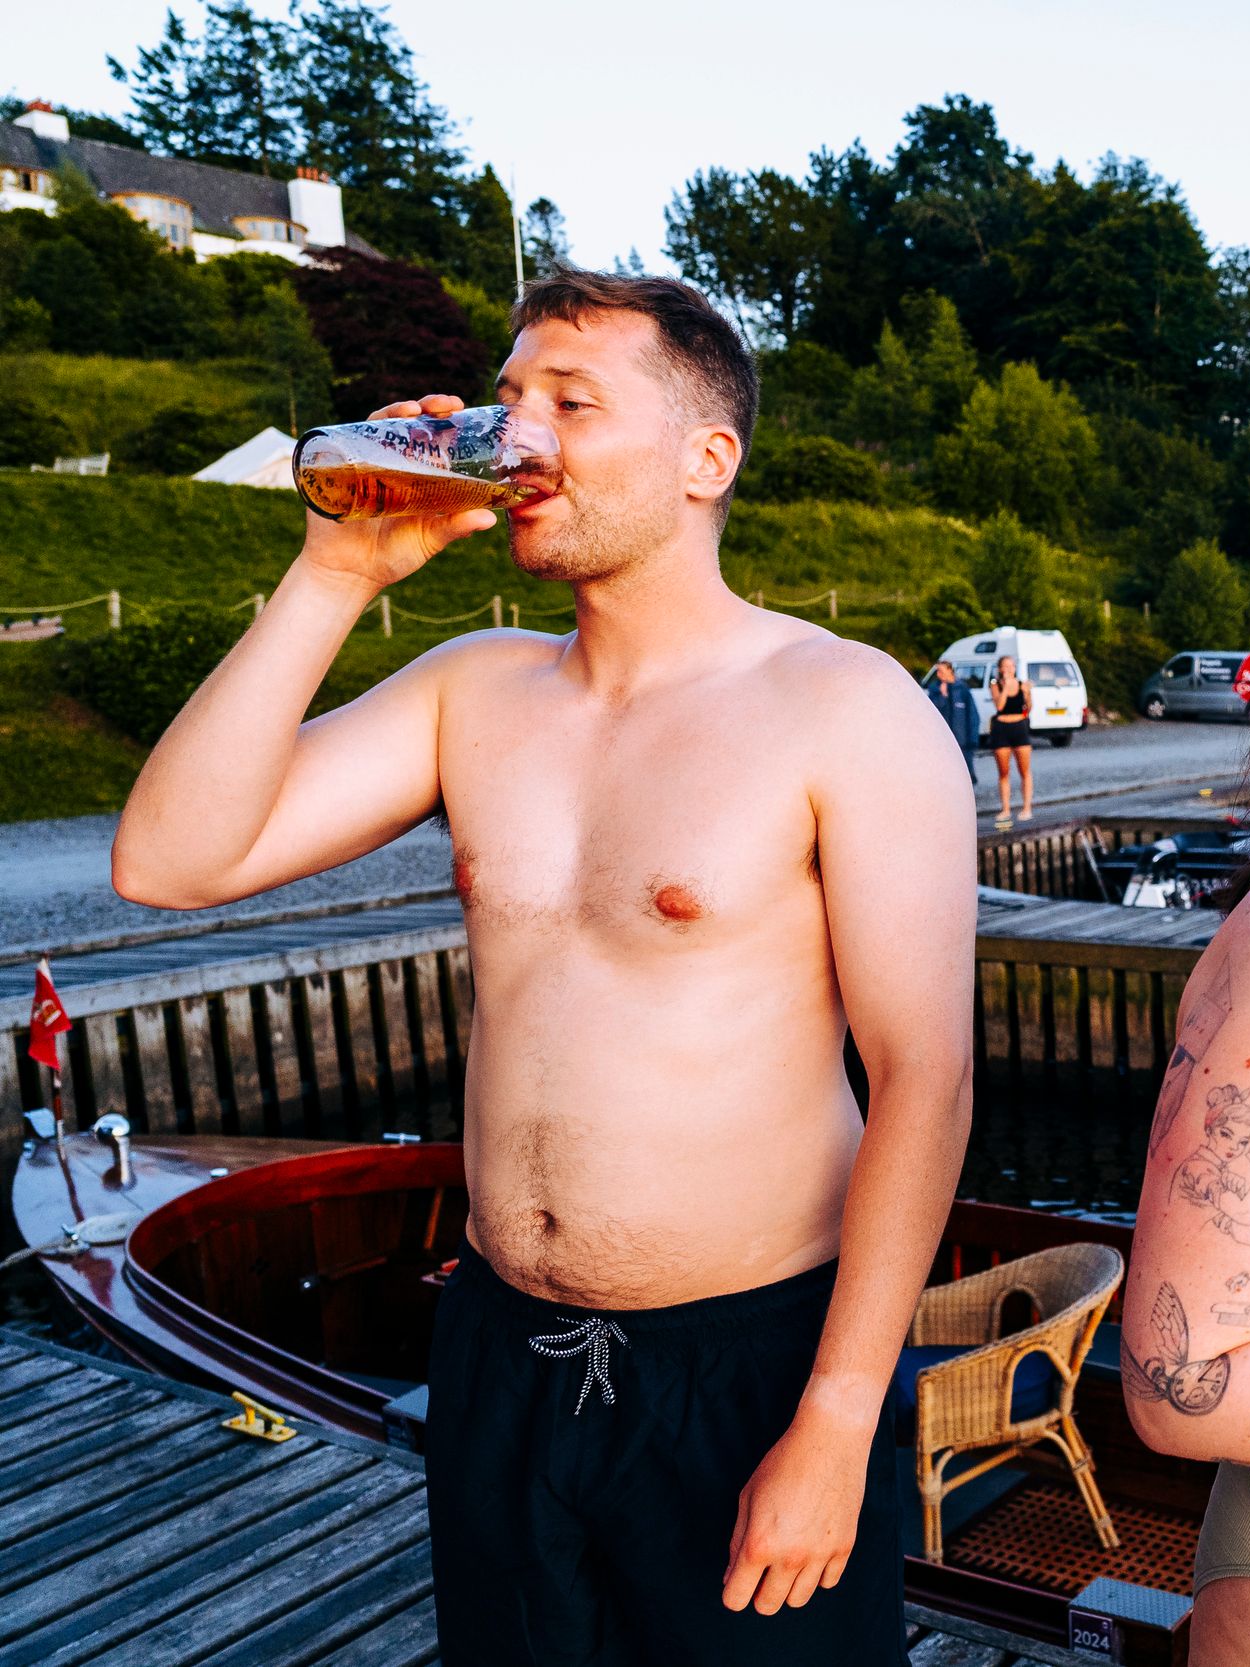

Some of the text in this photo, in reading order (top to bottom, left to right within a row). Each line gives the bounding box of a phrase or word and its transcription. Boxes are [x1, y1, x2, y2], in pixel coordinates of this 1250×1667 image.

[385, 430, 441, 458] DAMM
[447, 444, 479, 460] 1876
[1074, 1629, 1110, 1650] 2024
